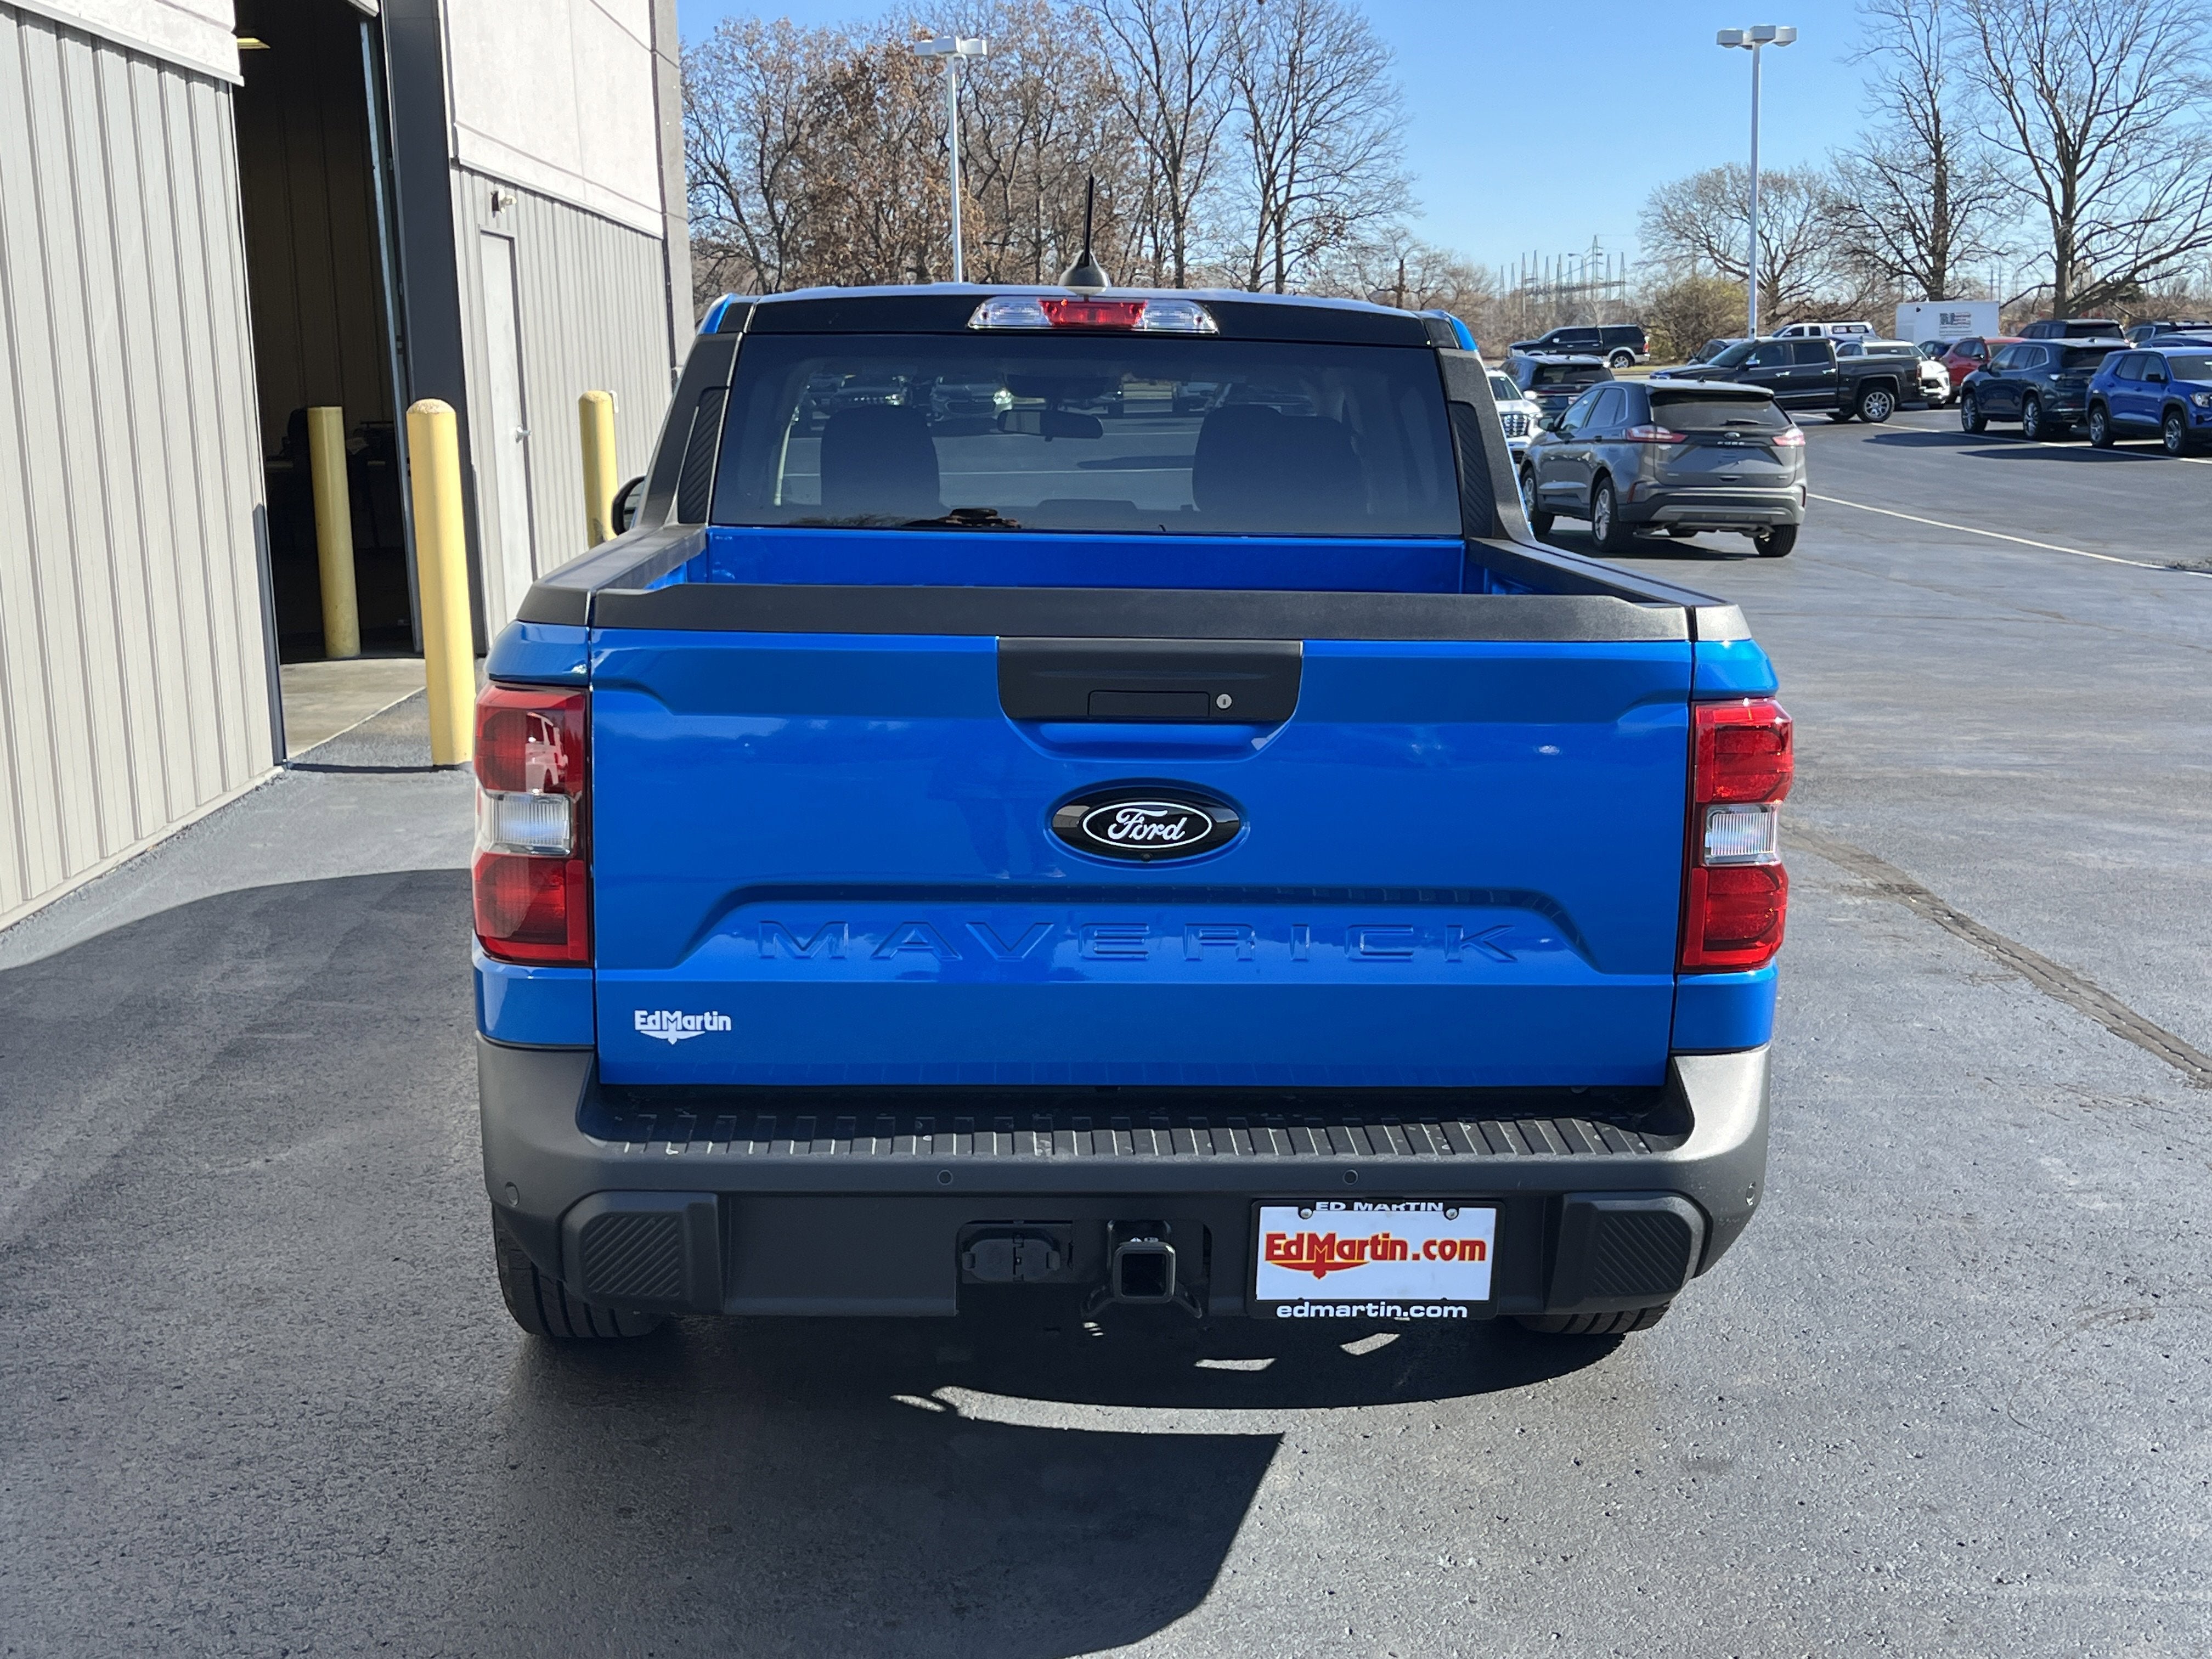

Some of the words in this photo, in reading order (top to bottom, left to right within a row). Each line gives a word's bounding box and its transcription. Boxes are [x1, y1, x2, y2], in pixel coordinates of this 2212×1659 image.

[1107, 808, 1188, 840] Ford
[758, 920, 1518, 963] MAVERICK
[634, 1010, 731, 1031] EdMartin
[1316, 1201, 1346, 1211] ED
[1353, 1201, 1443, 1211] MARTIN
[1265, 1232, 1487, 1263] EdMartin.com
[1276, 1301, 1468, 1318] edmartin.com
